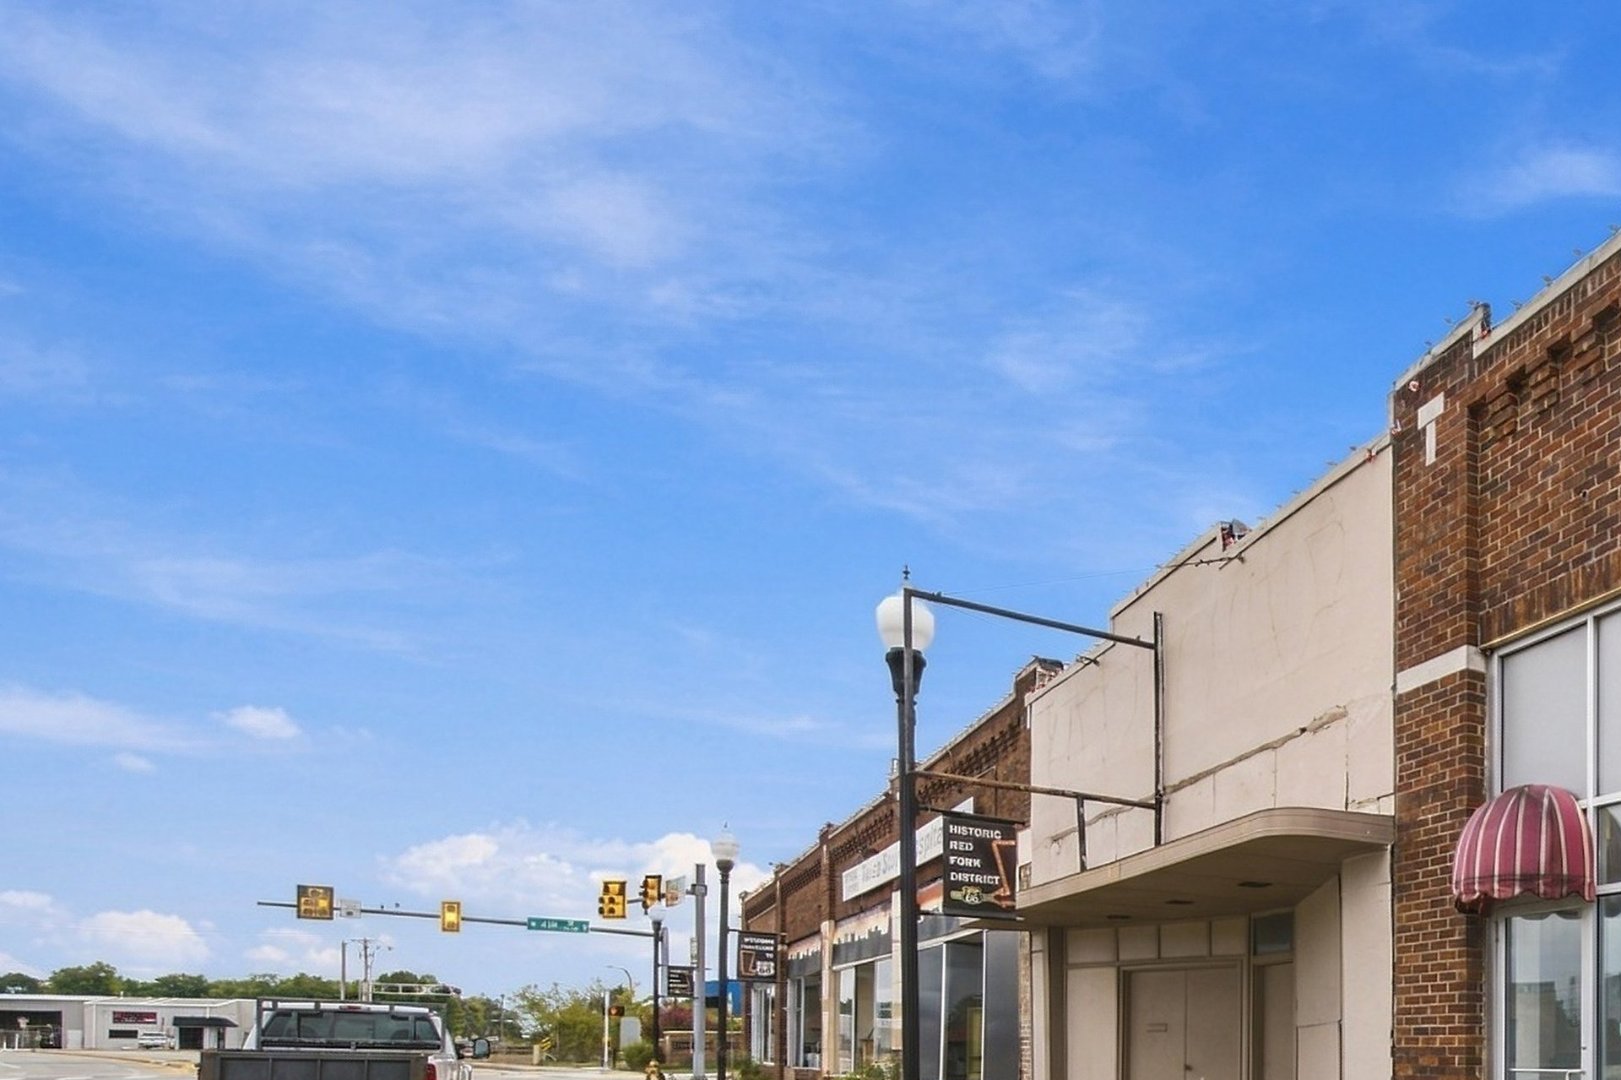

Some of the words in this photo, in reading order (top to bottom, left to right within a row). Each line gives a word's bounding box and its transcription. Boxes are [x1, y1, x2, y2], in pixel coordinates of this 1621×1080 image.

[949, 824, 1002, 839] HISTORIC
[949, 840, 974, 851] RED
[949, 856, 981, 868] FORK
[950, 872, 1000, 885] DISTRICT
